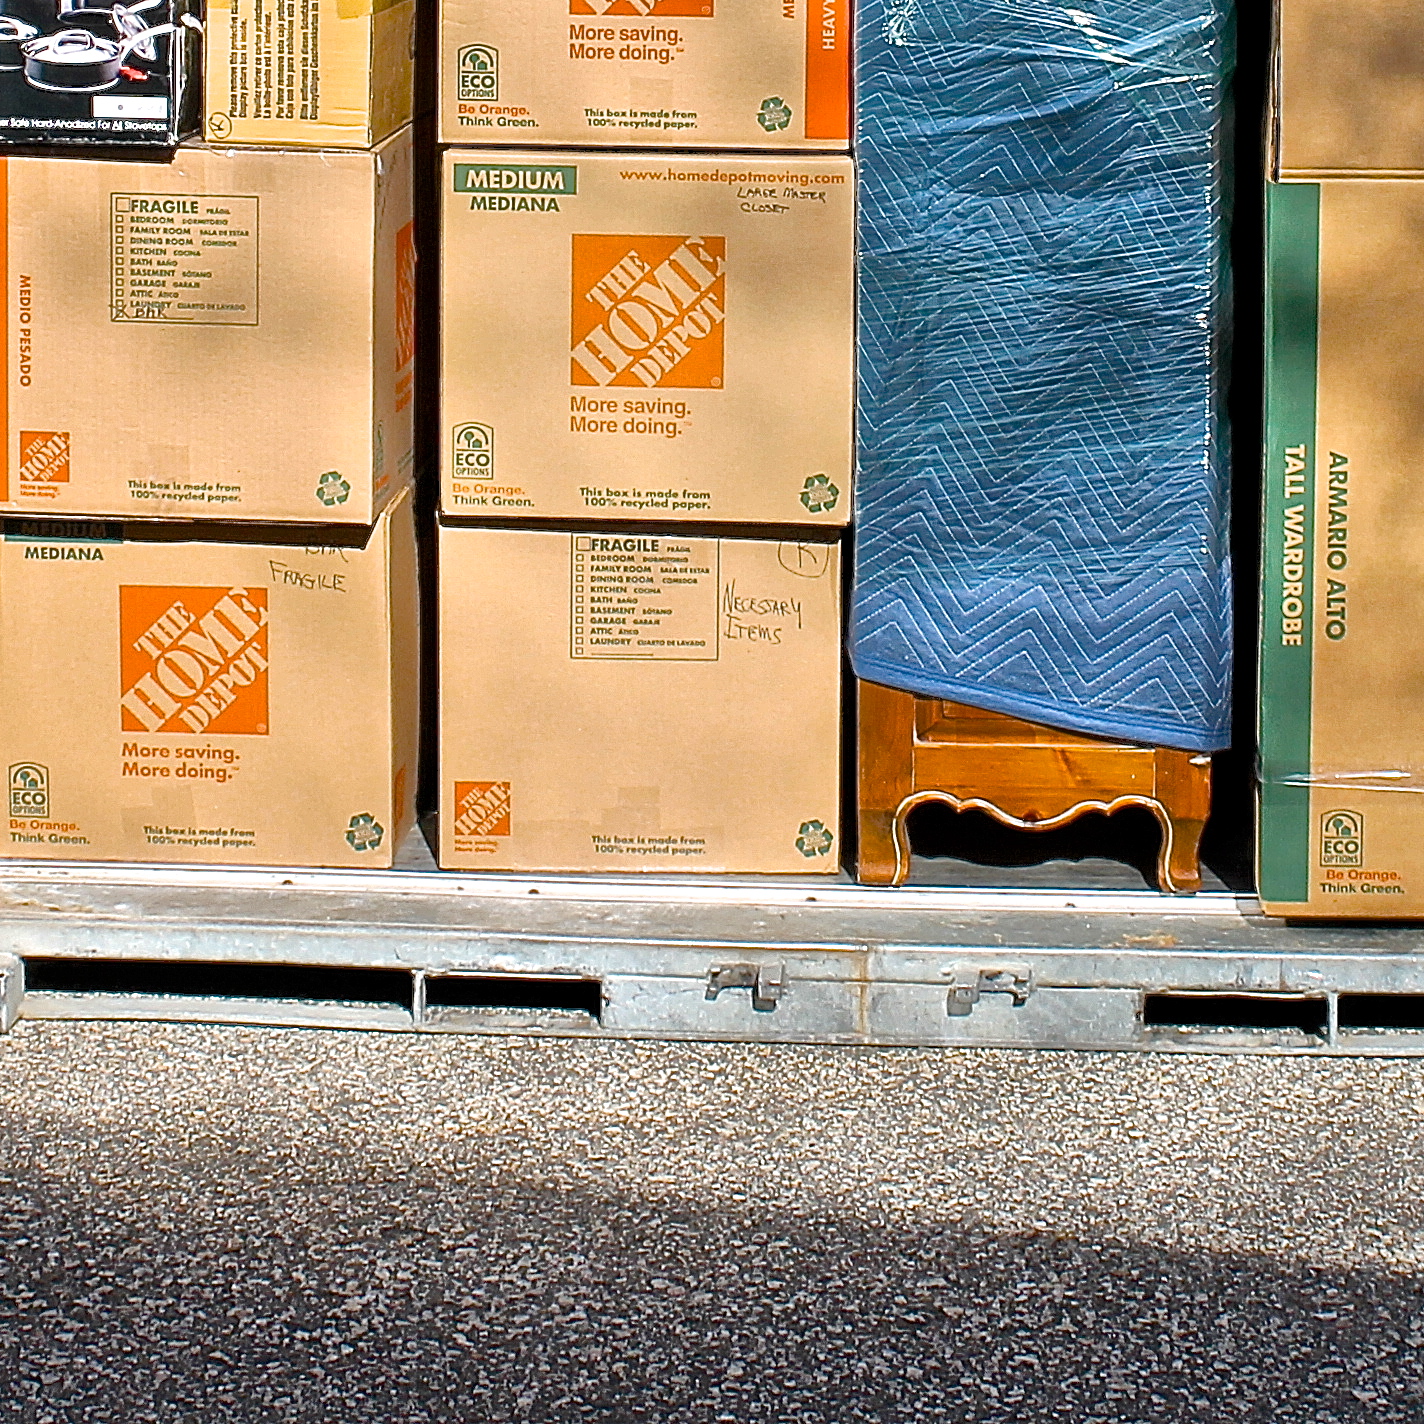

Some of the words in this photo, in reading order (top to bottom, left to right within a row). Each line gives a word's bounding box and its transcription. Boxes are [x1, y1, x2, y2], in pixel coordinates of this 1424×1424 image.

[569, 24, 615, 42] More
[619, 26, 684, 47] saving.
[569, 44, 615, 60] More
[619, 44, 675, 65] doing.
[460, 89, 495, 98] OPTIONS
[461, 75, 495, 89] ECO
[458, 104, 476, 115] Be
[480, 105, 530, 117] Orange.
[458, 116, 494, 128] Think
[497, 116, 540, 128] Green.
[466, 169, 565, 191] MEDIUM
[619, 168, 845, 186] www.homedepotmoving.com
[131, 200, 198, 213] FRAGILE
[469, 196, 560, 213] MEDIANA
[783, 187, 826, 204] MASTER
[741, 202, 790, 214] CLOSET
[585, 249, 651, 312] THE
[19, 274, 31, 325] MEDIO
[571, 236, 725, 387] HOME
[629, 293, 725, 388] DEPOT
[19, 328, 31, 387] PESADO
[570, 396, 619, 414] More
[623, 397, 691, 418] saving.
[570, 416, 618, 434] More
[623, 416, 682, 437] doing.
[20, 432, 70, 482] HOME
[26, 436, 46, 458] THE
[39, 452, 70, 482] DEPOT
[1283, 444, 1306, 500] TALL
[1327, 451, 1349, 571] ARMARIO
[24, 546, 104, 561] MEDIANA
[592, 538, 659, 552] FRAGILE
[268, 559, 347, 593] FRAGILE
[1280, 504, 1305, 647] WARDROBE
[722, 579, 803, 629] NECESSARY
[1324, 577, 1347, 641] ALTO
[133, 600, 198, 660] THE
[724, 615, 782, 645] ITEMS
[121, 587, 268, 733] HOME
[178, 641, 268, 735] DEPOT
[122, 742, 170, 759] More
[175, 744, 240, 763] saving.
[122, 762, 170, 779] More
[175, 764, 233, 784] doing.
[455, 781, 511, 836] HOME
[461, 787, 485, 809] THE
[477, 804, 511, 836] DEPOT
